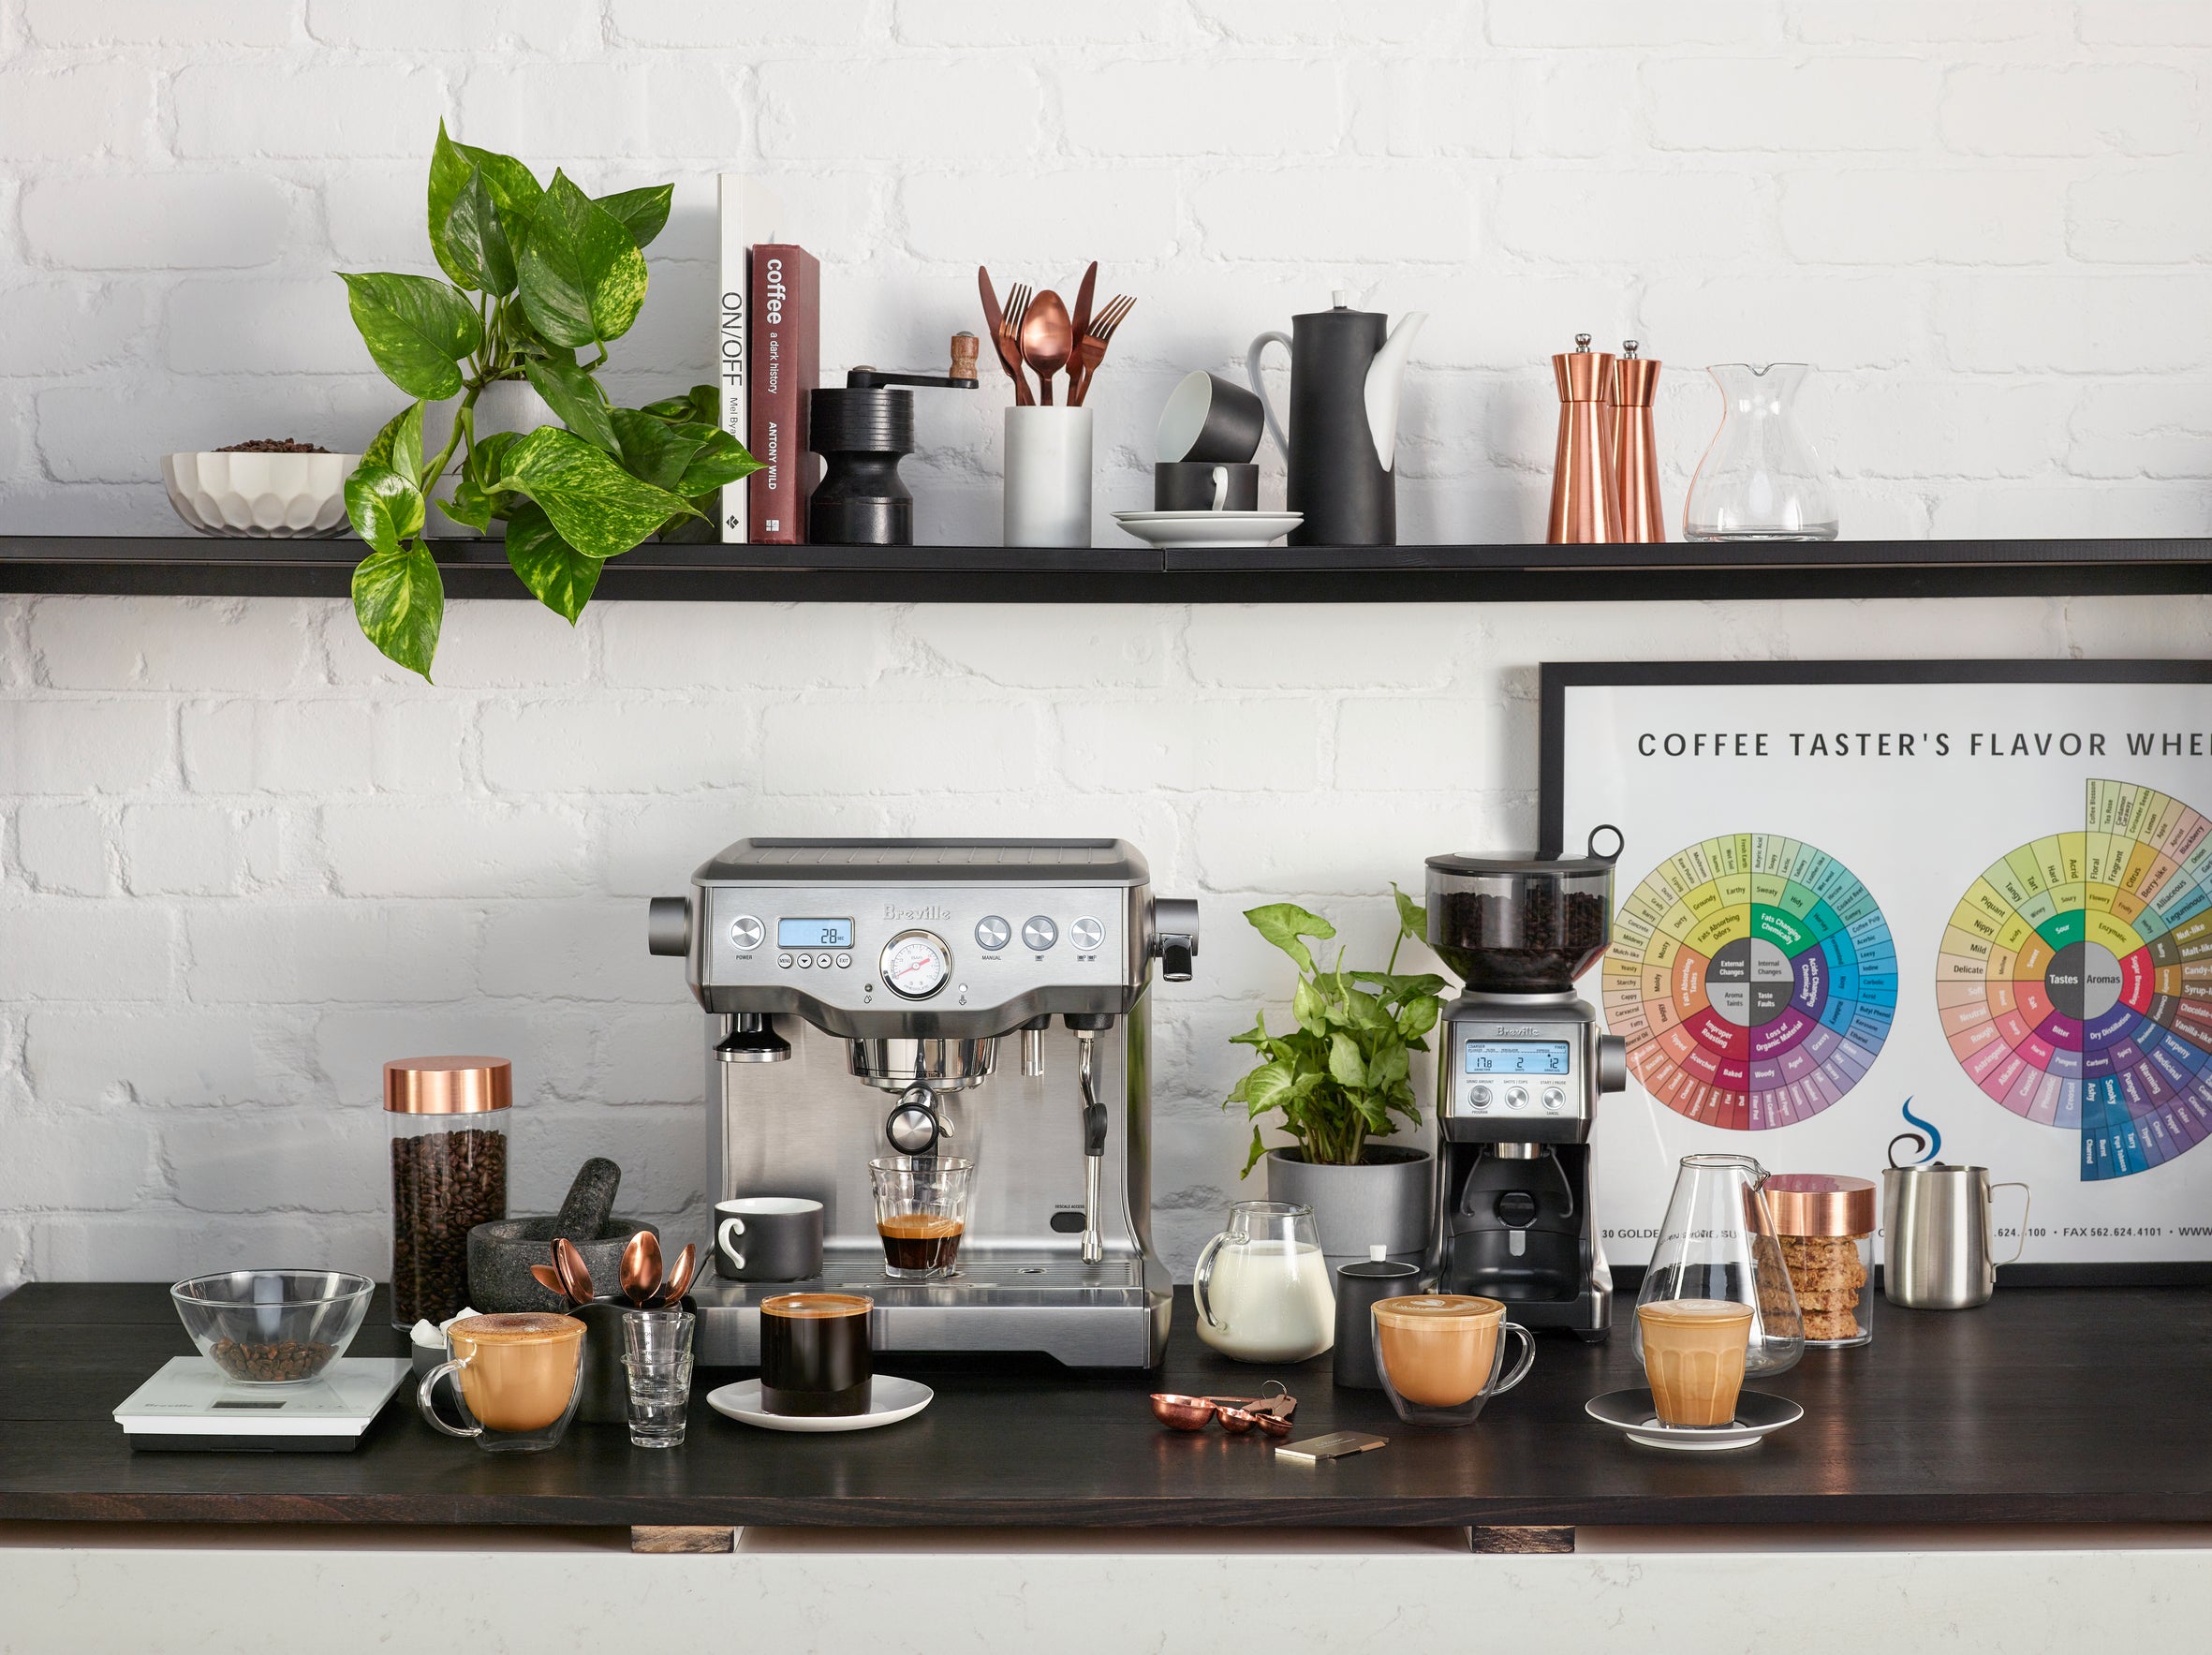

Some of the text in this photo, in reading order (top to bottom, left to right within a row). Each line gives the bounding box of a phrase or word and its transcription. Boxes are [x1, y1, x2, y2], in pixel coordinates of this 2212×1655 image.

[766, 259, 786, 324] coffee
[721, 292, 742, 386] ON/OFF
[770, 341, 779, 360] dark
[768, 363, 779, 394] history
[768, 421, 777, 489] ANTONY WILD
[1638, 732, 2212, 757] COFFEE TASTER'S FLAVOR WHE
[2145, 814, 2157, 835] Lemon
[2157, 823, 2168, 839] Apple
[2179, 825, 2205, 854] Blackberry
[2108, 850, 2124, 881] Fragrant
[2191, 849, 2206, 864] Onion
[2047, 865, 2059, 883] Hard
[2070, 859, 2078, 879] Acrid
[2090, 859, 2100, 879] Floral
[2127, 867, 2142, 888] Citrus
[1726, 887, 1746, 895] Earthy
[1756, 886, 1777, 896] Sweaty
[2028, 877, 2038, 891] Tart
[2142, 865, 2168, 898] Berry-like
[2005, 881, 2023, 903] Tangy
[2156, 880, 2187, 909] Alliaceous
[1693, 894, 1716, 910] Groundy
[1791, 896, 1804, 908] Hidy
[1981, 895, 2006, 918] Piquant
[2165, 894, 2205, 924] Leguminous
[883, 904, 951, 920] Breville
[1674, 915, 1688, 928] Dirty
[821, 929, 837, 943] 28
[1628, 920, 1649, 933] Concrete
[1698, 914, 1740, 942] Fats Absorbing
[1713, 927, 1732, 939] Odors
[1762, 913, 1802, 941] Fats Changing
[1762, 923, 1793, 945] Chemically
[1974, 920, 1995, 936] Nippy
[2056, 924, 2070, 935] Sour
[2099, 923, 2127, 942] Enzymatic
[2176, 924, 2205, 940] Nut-like
[1659, 941, 1671, 959] Musty
[1970, 944, 1986, 954] Mild
[1681, 958, 1694, 991] Absorbing
[1954, 965, 1983, 973] Delicate
[1800, 965, 1811, 1000] Chemically
[1806, 957, 1819, 1008] Acids Changing
[2050, 975, 2078, 983] Tastes
[2087, 975, 2120, 983] Aromas
[1968, 987, 1983, 996] Soft
[1959, 1007, 1986, 1022] Neutral
[1498, 1027, 1540, 1037] Breville
[1705, 1020, 1733, 1039] Improper
[1756, 1020, 1804, 1052] Organic Material
[1765, 1023, 1788, 1040] Loss of
[1970, 1027, 1994, 1043] Rough
[2052, 1026, 2070, 1038] Bitter
[2090, 1013, 2131, 1040] Dry Distillation
[1702, 1028, 1728, 1049] Roasting
[1812, 1033, 1829, 1051] Grassy
[2164, 1035, 2190, 1058] Turpeny
[1517, 1057, 1524, 1068] 2
[1550, 1058, 1558, 1069] 12
[1689, 1053, 1716, 1071] Scorched
[1788, 1057, 1803, 1069] Aged
[1974, 1043, 2007, 1073] Astringent
[2154, 1051, 2182, 1081] Medicinal
[1723, 1069, 1743, 1078] Baked
[1755, 1070, 1775, 1078] Woody
[1998, 1059, 2021, 1086] Alkaline
[2139, 1062, 2160, 1095] Warming
[2020, 1071, 2038, 1097] Caustic
[2086, 1083, 2095, 1101] Ashy
[2105, 1079, 2116, 1105] Smoky
[2123, 1072, 2141, 1102] Pungent
[2066, 1083, 2075, 1111] Creosol
[2090, 1228, 2161, 1236] 562.624.4101
